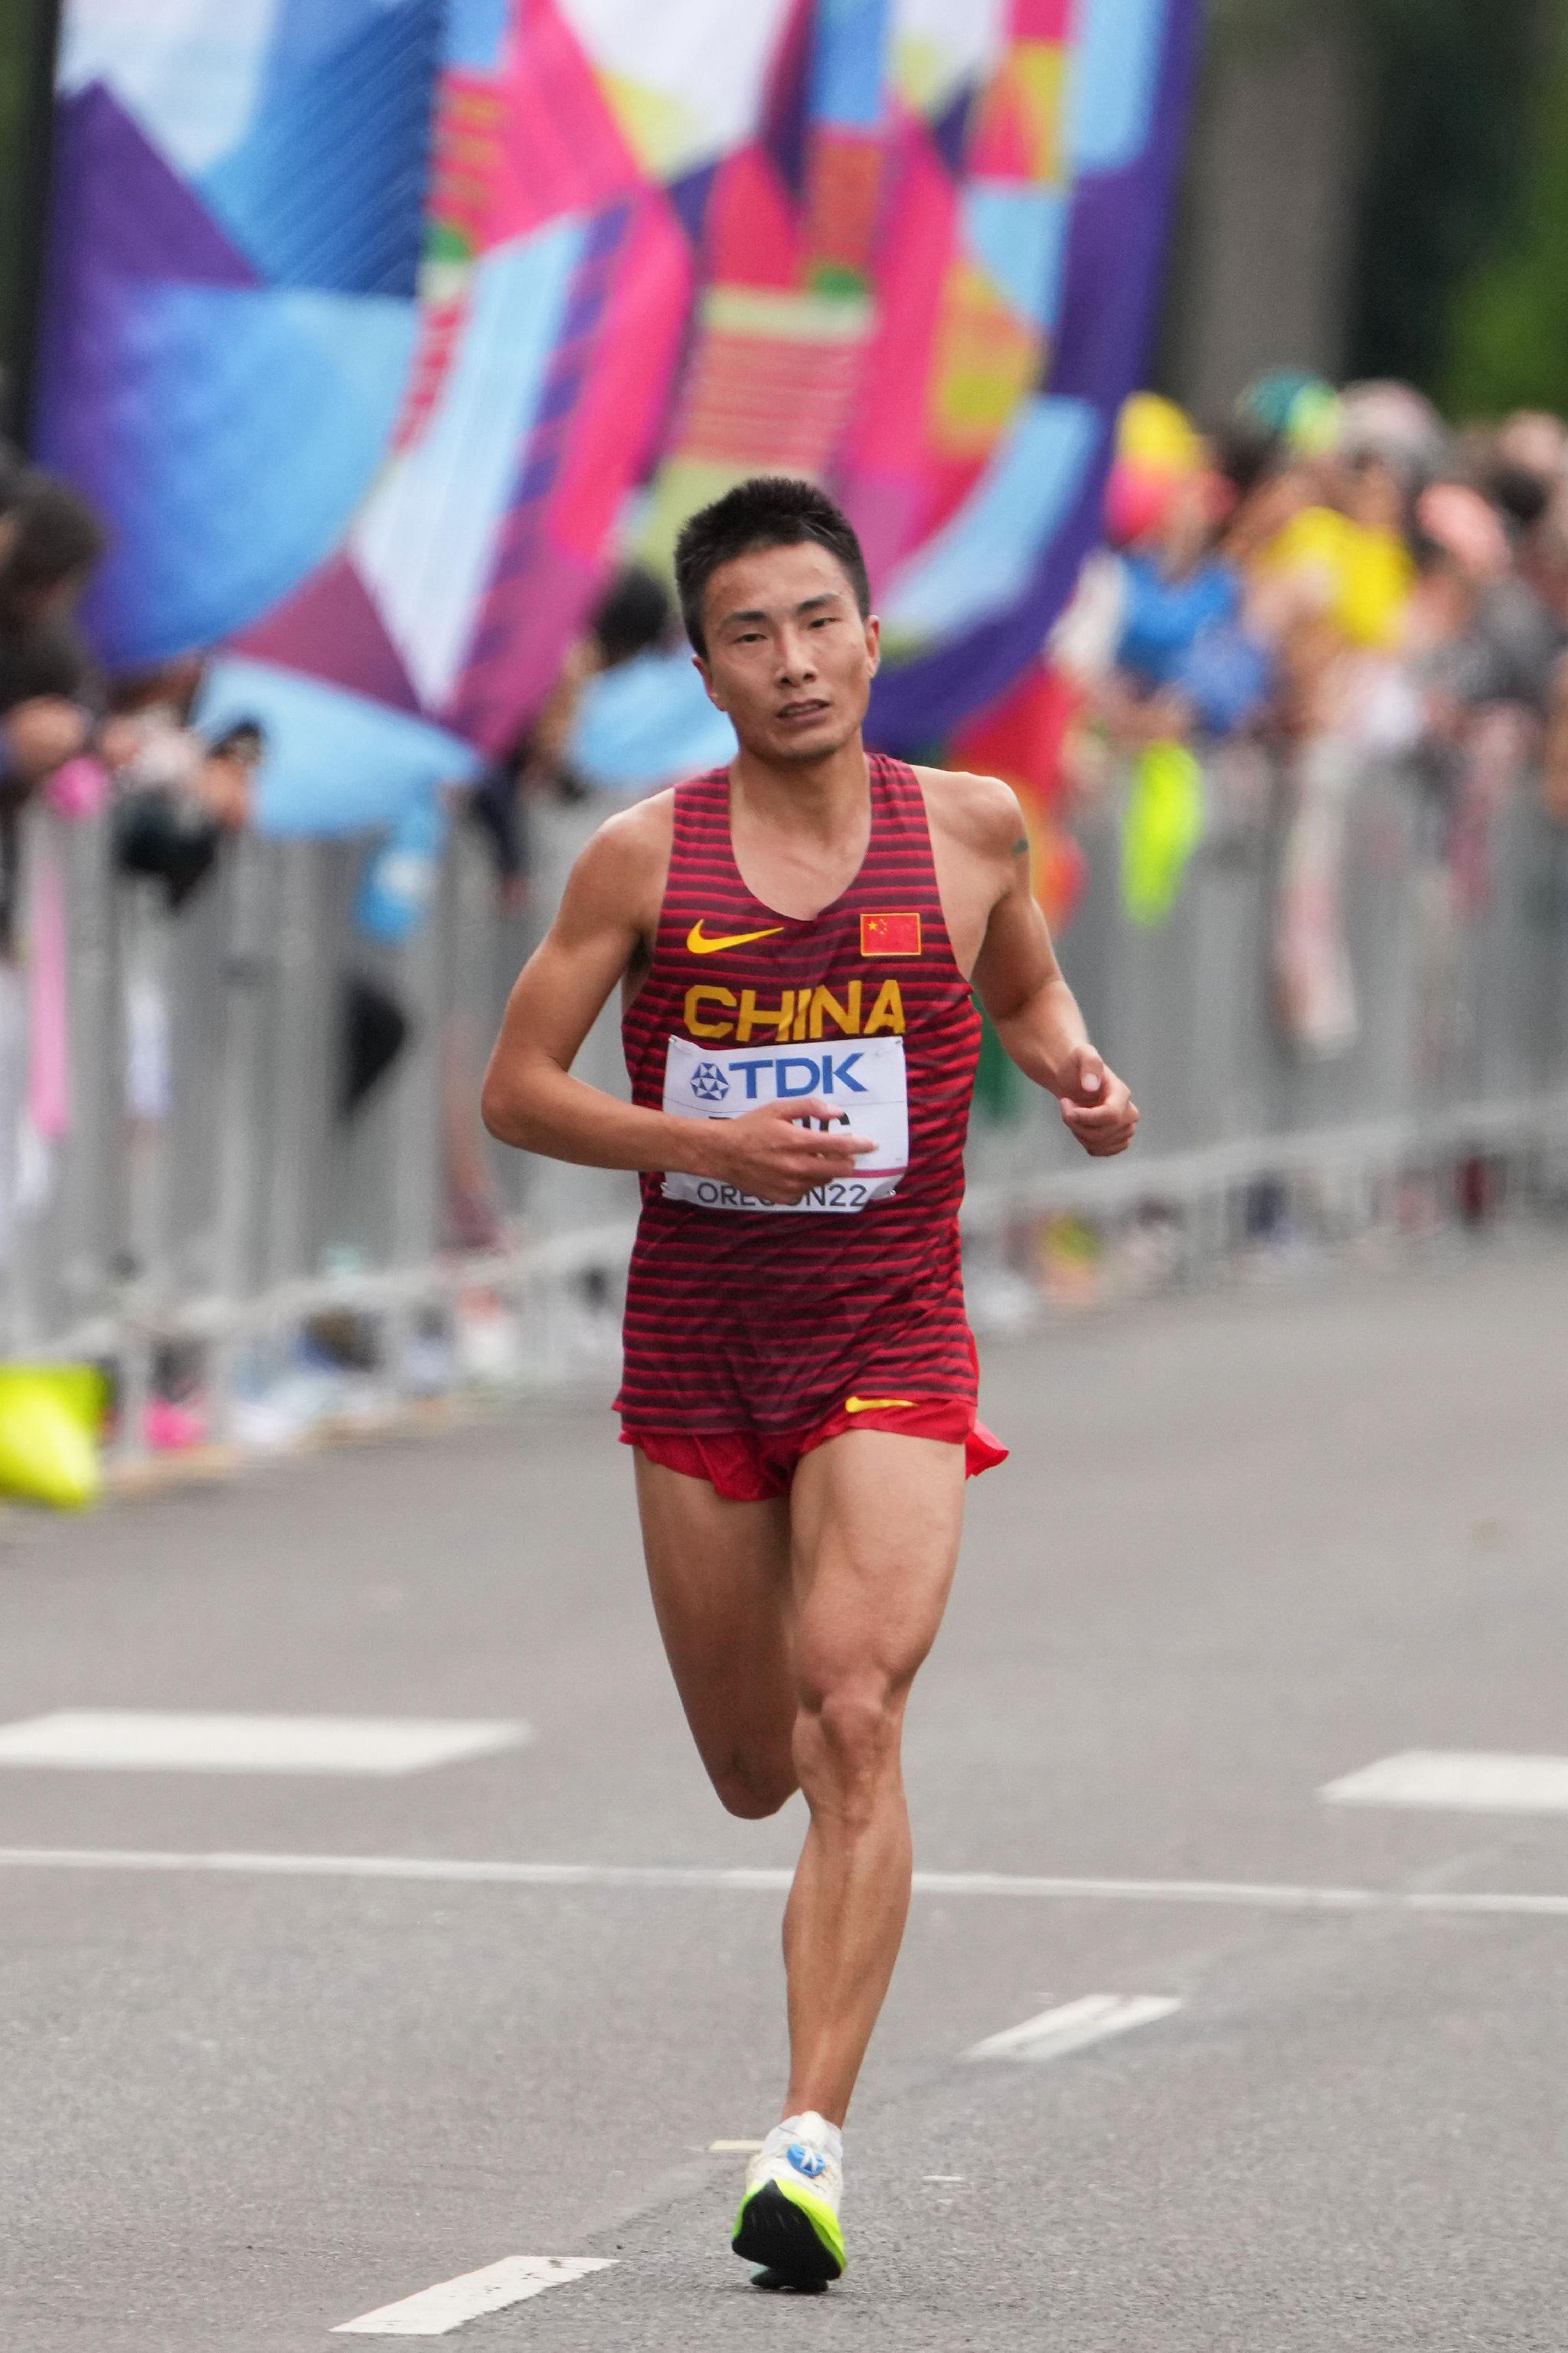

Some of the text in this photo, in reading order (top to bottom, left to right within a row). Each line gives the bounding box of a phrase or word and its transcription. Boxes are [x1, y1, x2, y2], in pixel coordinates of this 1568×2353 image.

[683, 979, 906, 1042] CHINA
[728, 1052, 870, 1099] TDK
[697, 1181, 867, 1207] OREN22
